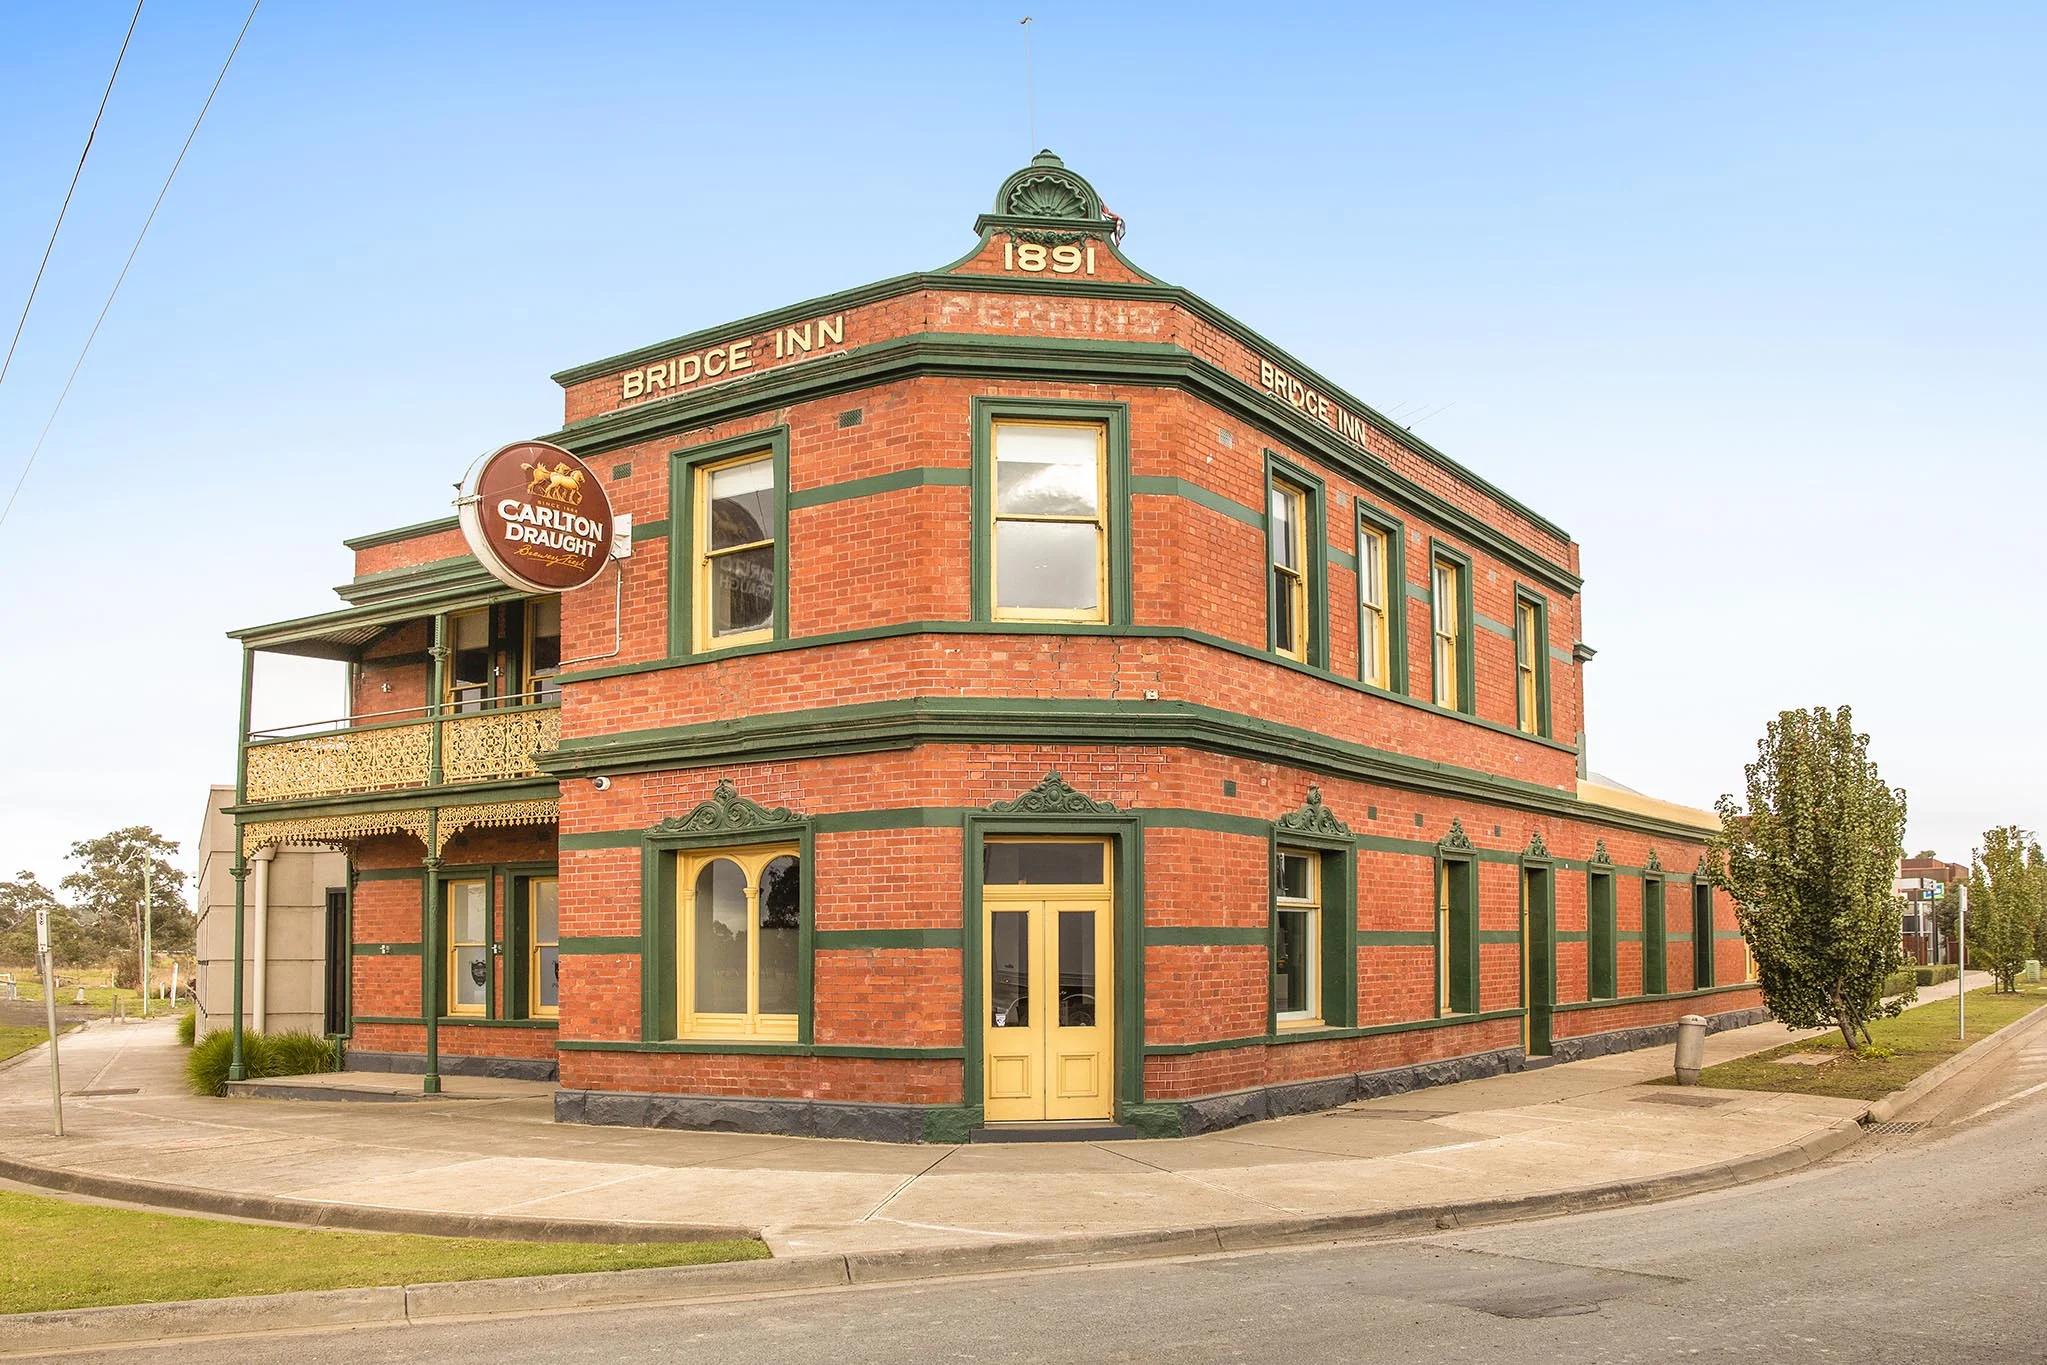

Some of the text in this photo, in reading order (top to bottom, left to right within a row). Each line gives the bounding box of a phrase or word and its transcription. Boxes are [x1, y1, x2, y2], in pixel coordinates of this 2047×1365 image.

[1004, 243, 1095, 275] 1891
[776, 316, 843, 358] INN
[1338, 408, 1366, 446] INN
[497, 499, 603, 542] CARLTON
[537, 500, 560, 509] SINCE
[505, 521, 597, 558] DRAUGHT
